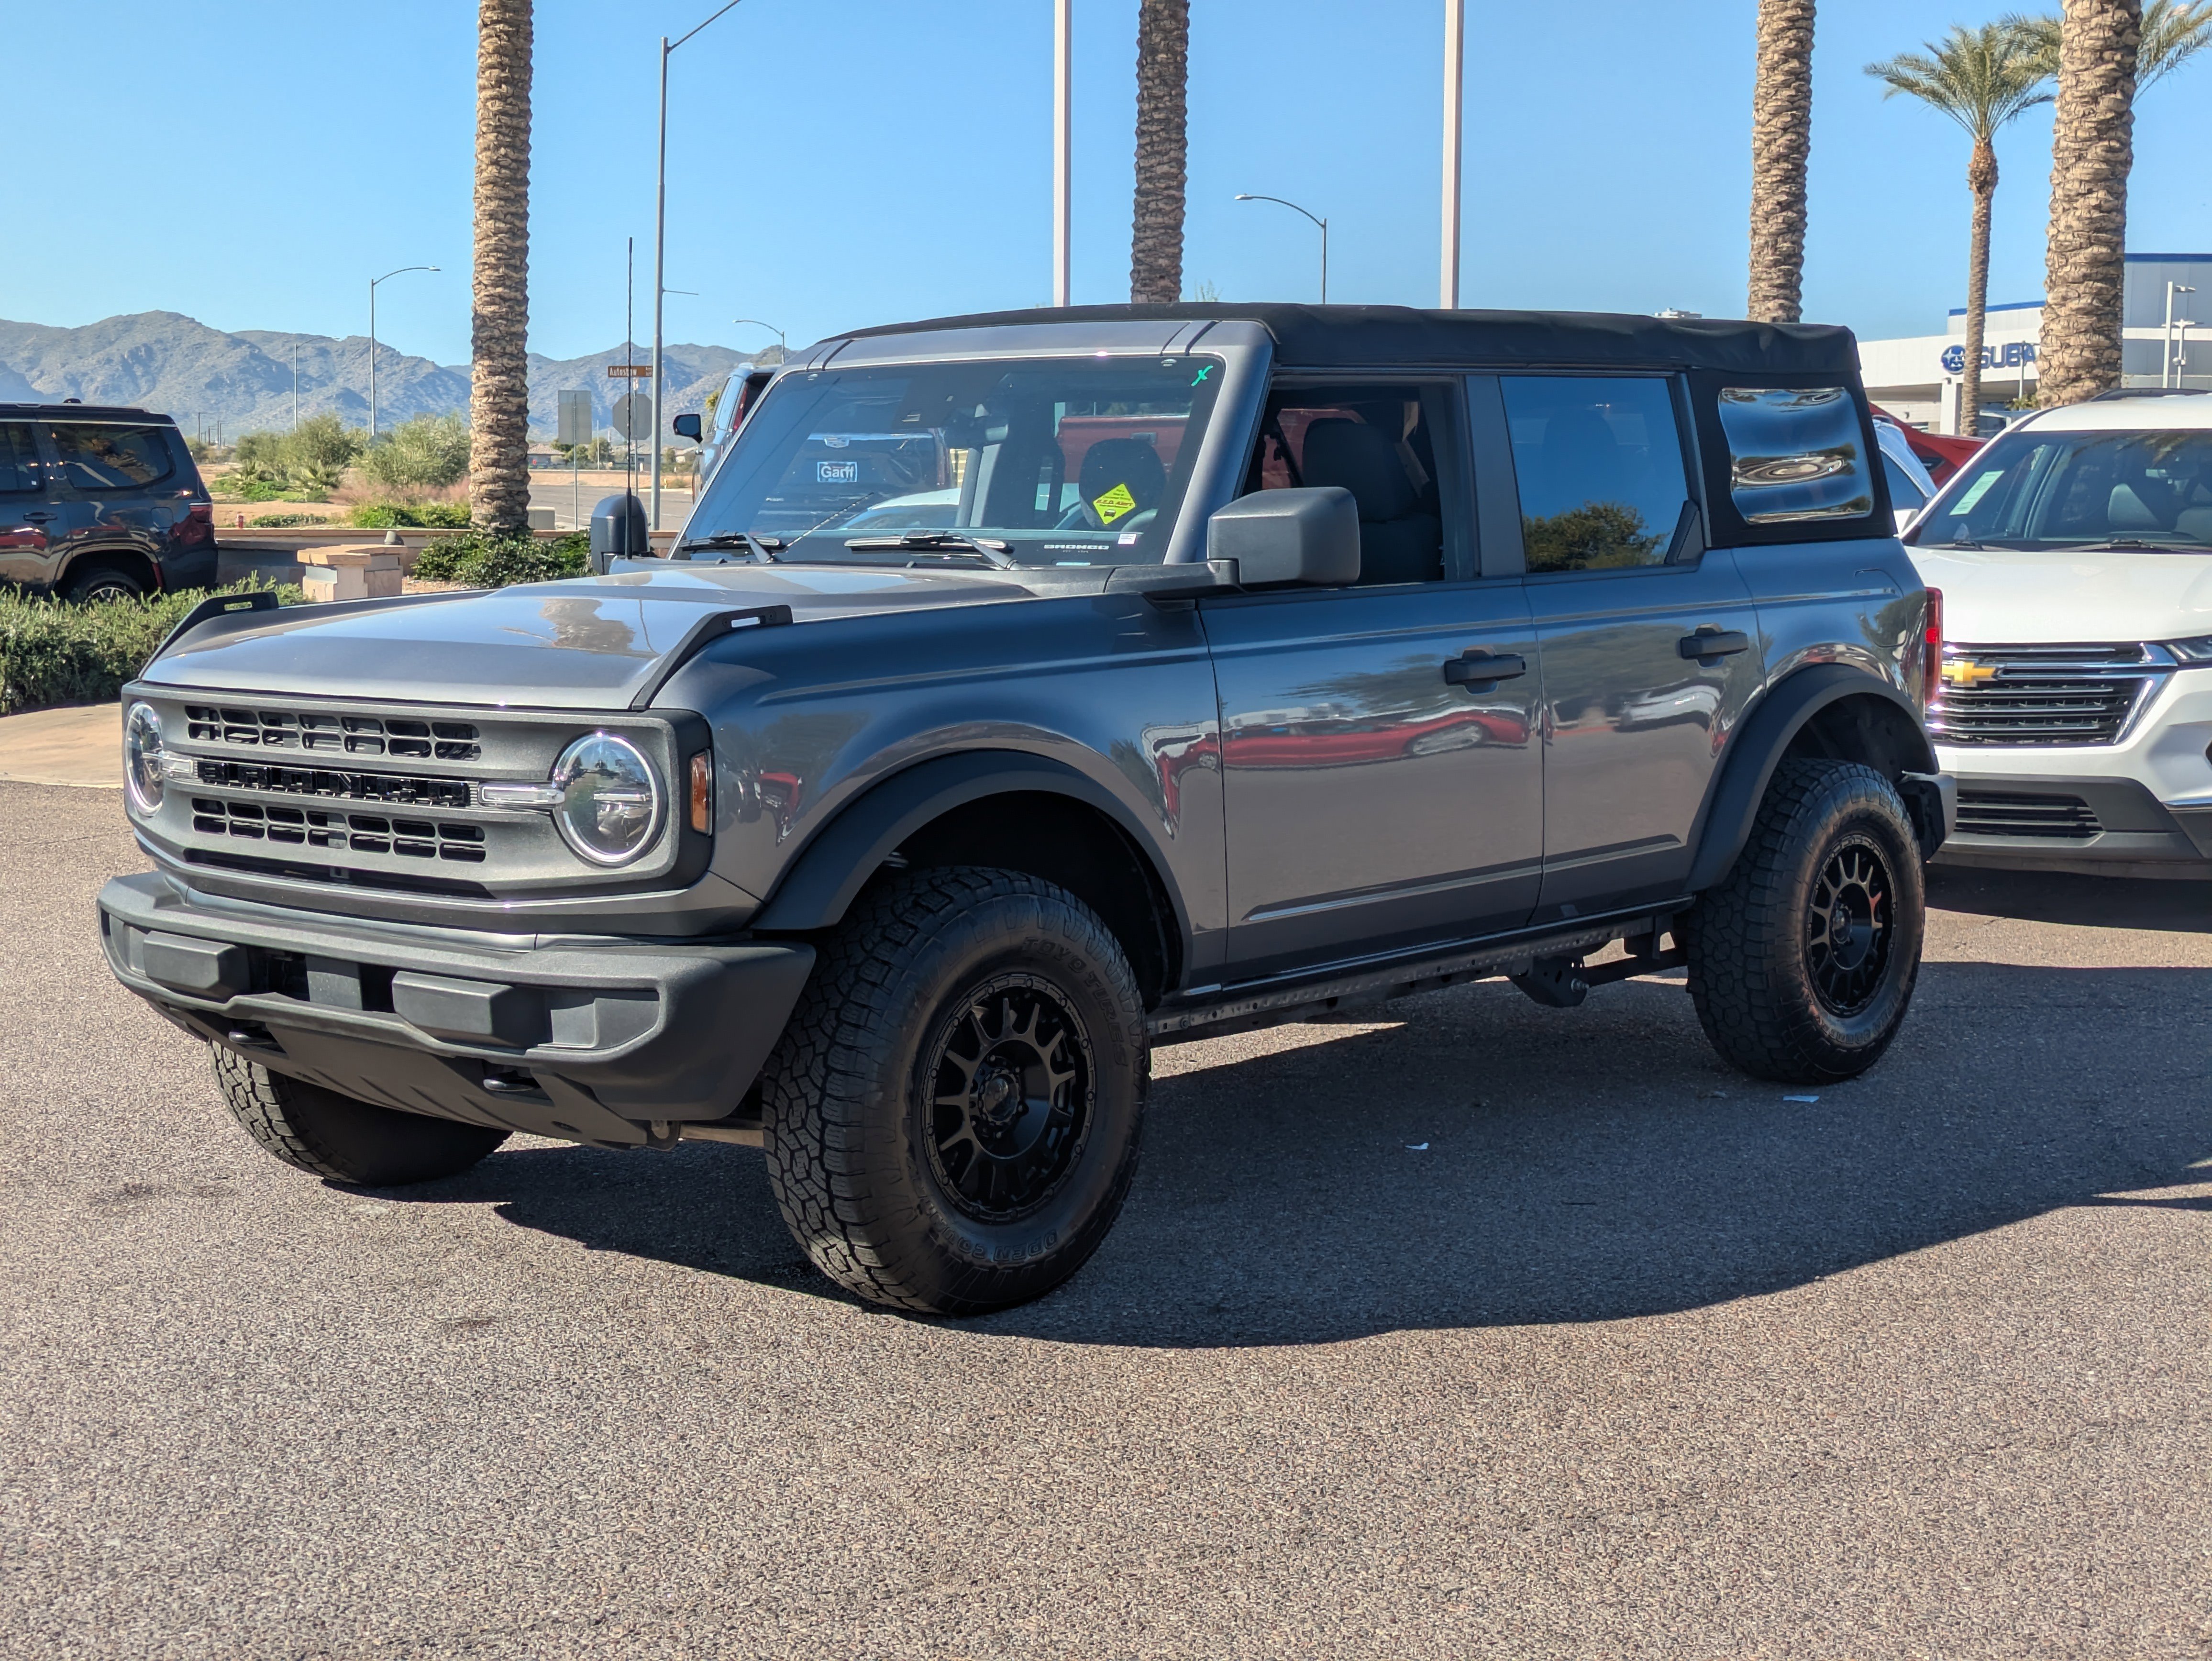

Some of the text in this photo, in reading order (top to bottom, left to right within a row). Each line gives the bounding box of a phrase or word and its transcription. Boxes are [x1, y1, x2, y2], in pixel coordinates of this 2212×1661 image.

[197, 761, 469, 807] BRONCO
[1022, 936, 1128, 1067] TOYO TIRES
[993, 1229, 1058, 1262] OPEN
